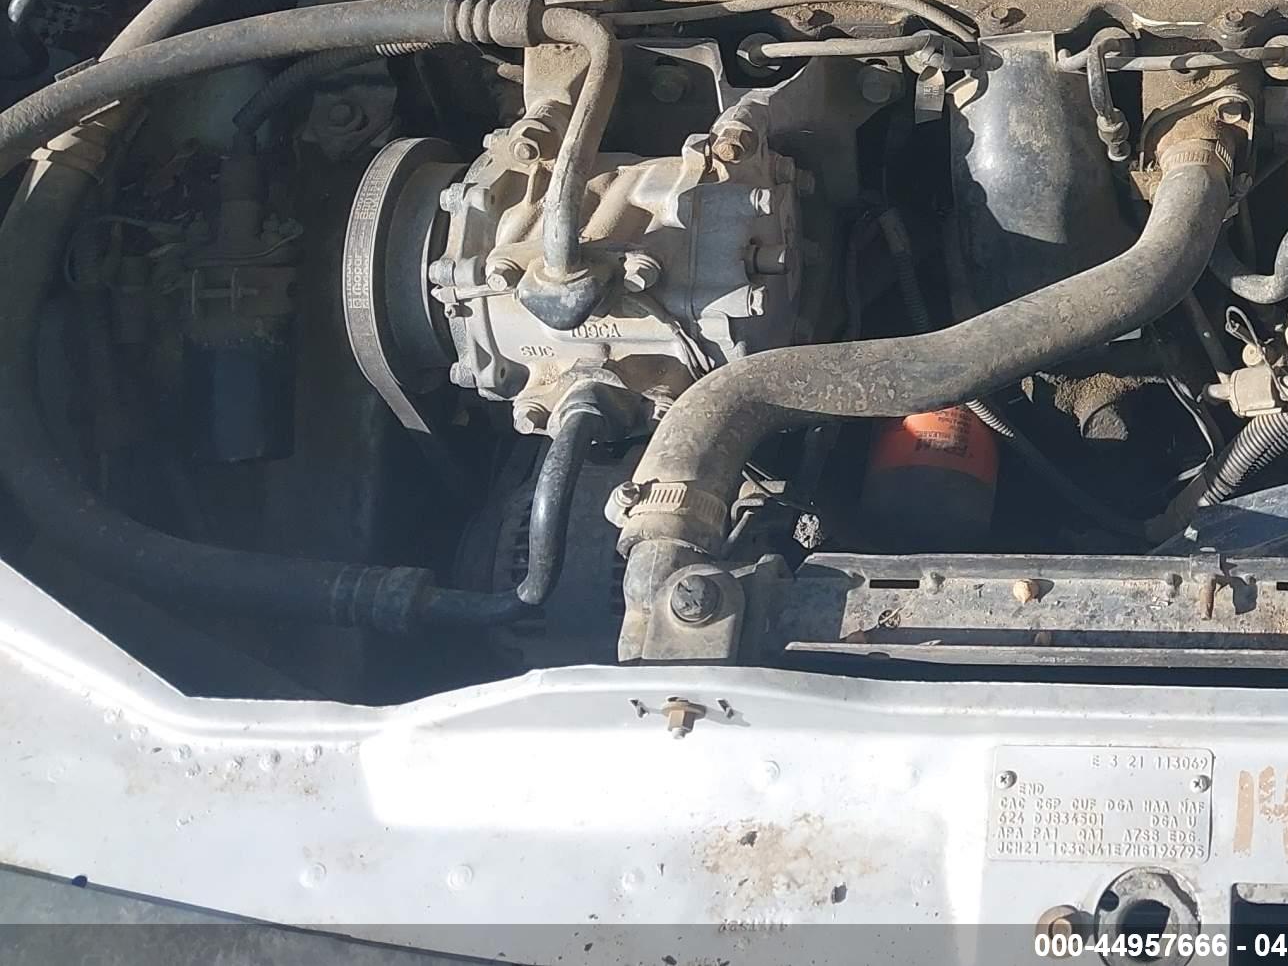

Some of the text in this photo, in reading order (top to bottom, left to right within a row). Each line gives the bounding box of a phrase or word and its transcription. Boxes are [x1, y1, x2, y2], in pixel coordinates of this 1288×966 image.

[1110, 755, 1119, 768] 3
[1128, 755, 1144, 769] 21
[1155, 756, 1209, 770] 113069
